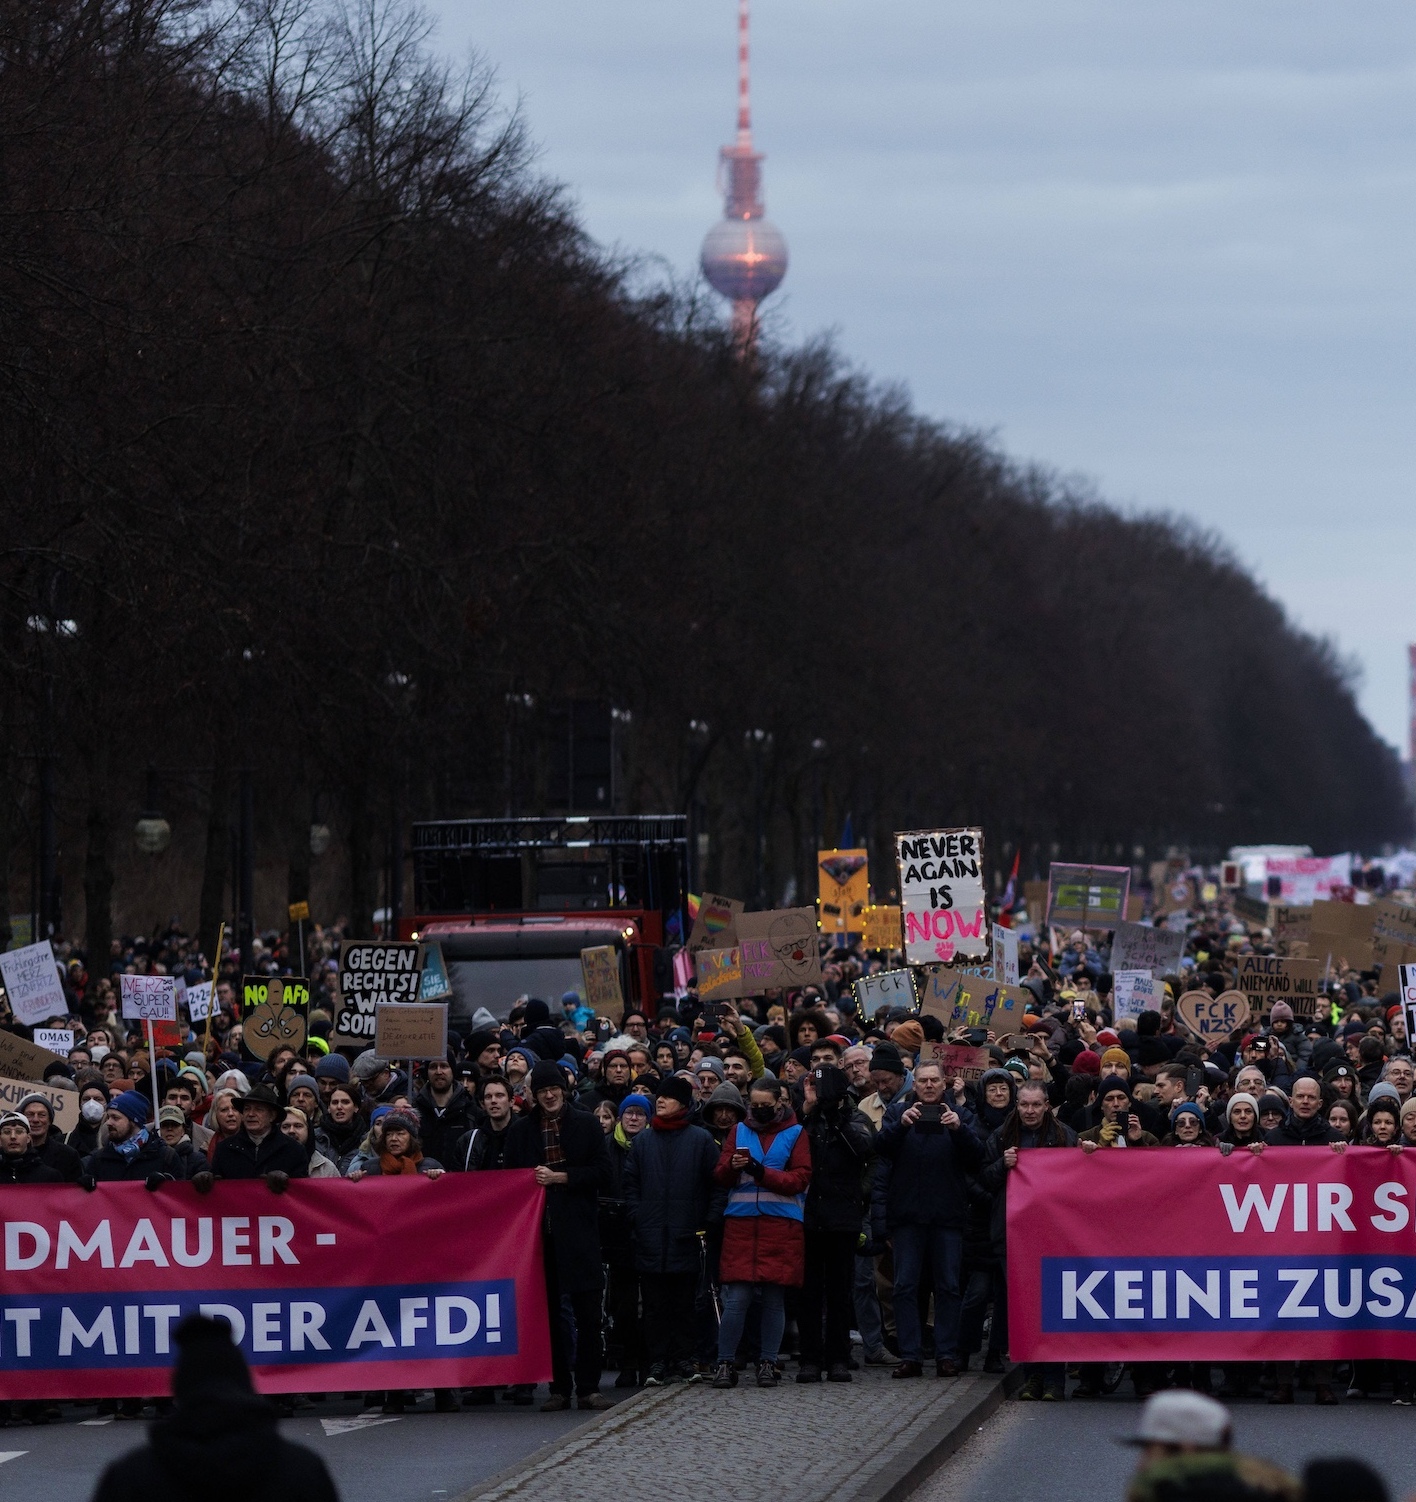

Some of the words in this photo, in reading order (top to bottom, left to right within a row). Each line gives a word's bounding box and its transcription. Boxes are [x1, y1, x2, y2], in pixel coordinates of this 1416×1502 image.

[902, 836, 976, 860] NEVER
[905, 858, 979, 884] AGAIN
[929, 885, 953, 909] IS
[906, 910, 983, 943] NOW
[347, 947, 416, 971] GEGEN
[742, 940, 769, 961] FCK
[743, 962, 774, 979] MRZ
[123, 977, 164, 994] MERZ
[342, 971, 418, 1001] RECHTS!
[865, 977, 905, 995] FCK
[1240, 974, 1290, 992] NIEMAND
[134, 993, 170, 1006] SUPER
[244, 984, 268, 1007] NO
[1195, 1003, 1237, 1018] FCK
[382, 1031, 436, 1041] DEMOKRATIE
[1200, 1018, 1235, 1034] NZS
[40, 1032, 70, 1043] OMAS
[1218, 1182, 1357, 1232] WIR
[1061, 1269, 1260, 1320] KEINE
[58, 1304, 181, 1357] MIT
[344, 1293, 501, 1351] AFD!
